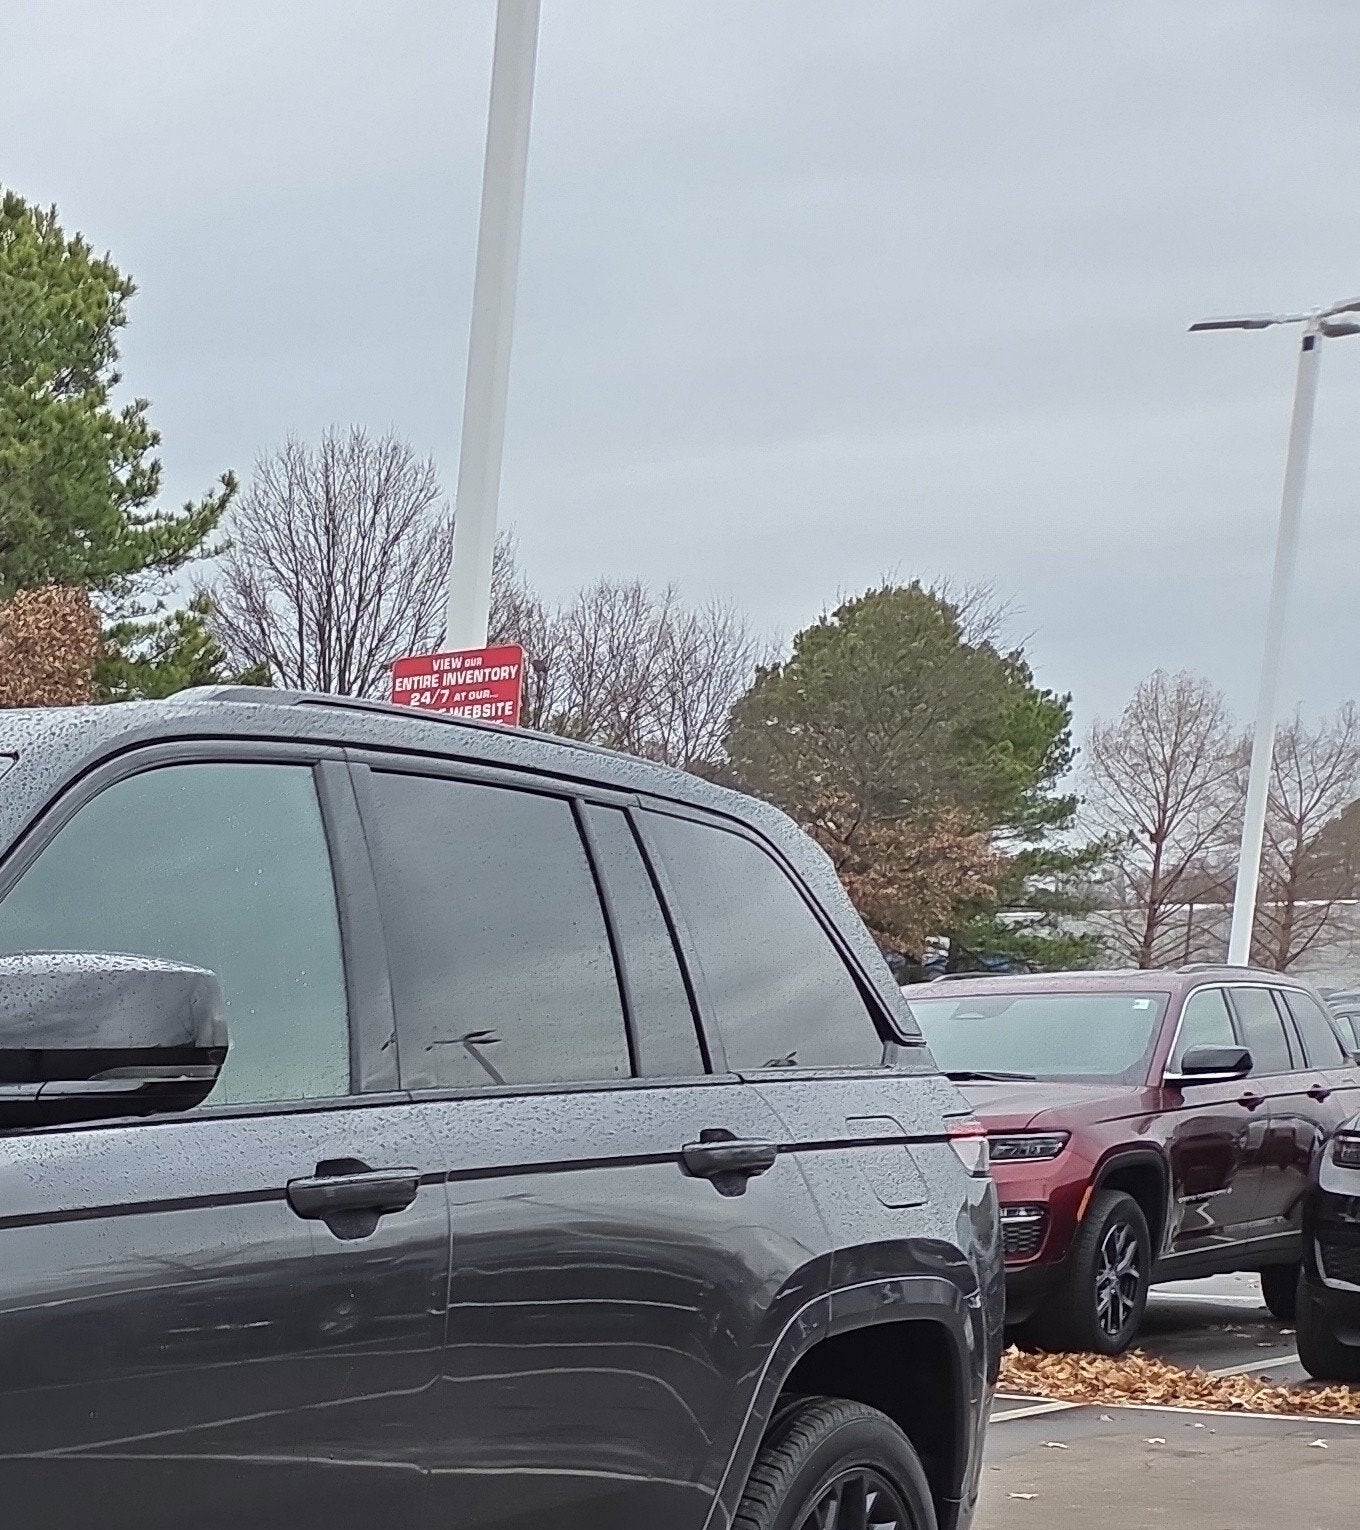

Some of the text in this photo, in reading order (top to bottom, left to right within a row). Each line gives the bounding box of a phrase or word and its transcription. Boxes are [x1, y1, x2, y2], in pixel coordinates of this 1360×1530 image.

[432, 657, 483, 671] VIEW OUR
[395, 664, 519, 692] ENTIRE INVENTORY
[410, 688, 450, 706] 24/7
[453, 691, 467, 702] AT
[449, 700, 514, 719] WEBSITE
